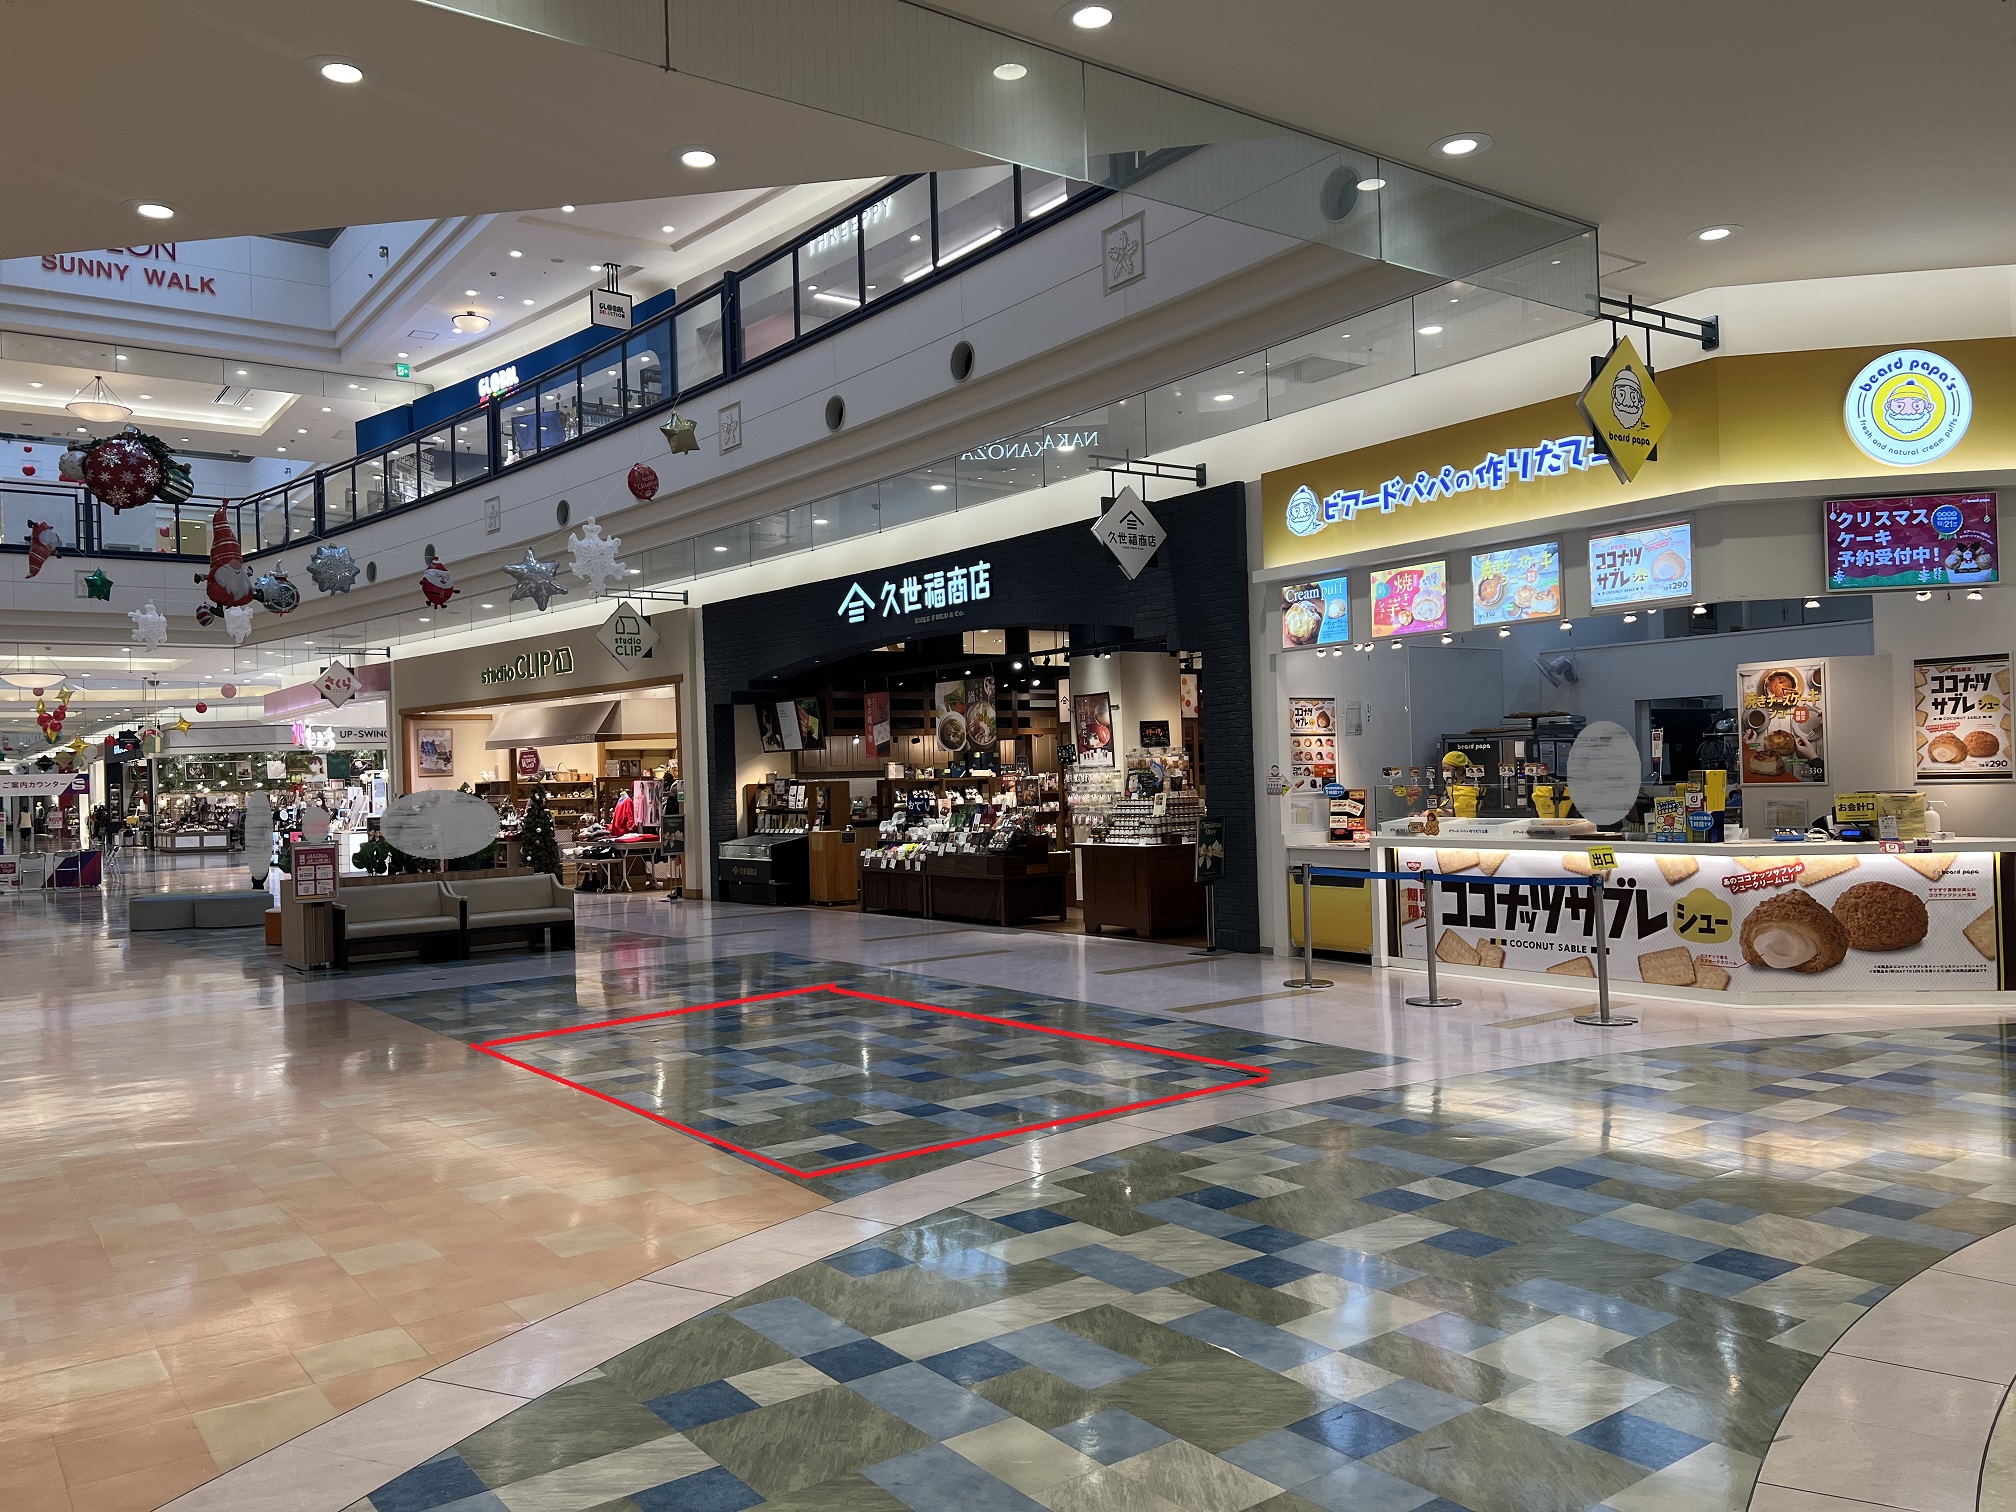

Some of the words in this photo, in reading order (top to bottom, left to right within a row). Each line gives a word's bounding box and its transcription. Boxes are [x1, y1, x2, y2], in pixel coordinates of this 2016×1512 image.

[41, 254, 129, 281] SUNNY
[143, 267, 216, 295] WALK
[599, 302, 625, 314] GLOBAL
[599, 309, 626, 319] SELECTION
[478, 365, 520, 397] GLOBAL
[1859, 357, 1903, 392] beard
[1909, 359, 1957, 391] papa's
[1608, 431, 1630, 442] beard
[1632, 437, 1650, 447] papa
[1859, 419, 1872, 439] fresh
[1872, 438, 1888, 450] and
[1888, 448, 1920, 456] natural
[1922, 437, 1945, 453] cream
[1944, 418, 1958, 438] puffs
[1837, 508, 1929, 529] クリスマス
[1108, 531, 1156, 547] 久世福商店
[1837, 529, 1892, 548] ケーキ
[1482, 551, 1553, 580] 焼きチーズケーキ
[1595, 547, 1643, 570] ココナッツ
[1838, 546, 1940, 568] 予約受付中！
[880, 560, 991, 618] 久世福商店
[1500, 574, 1527, 586] シュー
[1597, 567, 1630, 590] サブレ
[1633, 572, 1649, 582] シュー
[1285, 588, 1319, 603] Cream
[1320, 580, 1344, 601] puff
[915, 616, 931, 624] KUZE
[615, 637, 642, 645] studio
[615, 645, 642, 656] CLIP
[481, 664, 515, 685] studio
[515, 650, 552, 680] CLIP
[324, 675, 352, 691] さくら
[1931, 672, 1992, 694] ココナッツ
[1745, 688, 1820, 709] 焼きチーズケーキ
[1932, 693, 1975, 715] サブレ
[1978, 699, 1999, 710] シュー
[1769, 708, 1795, 719] シュー
[1457, 742, 1475, 750] beard
[1475, 743, 1491, 751] papa
[2, 781, 67, 789] ご案内カウンター
[1838, 802, 1875, 812] お会計口
[1690, 820, 1712, 828] 1時間です
[1592, 853, 1614, 866] 出口
[1723, 864, 1803, 886] あのココナッツサブレが
[1441, 877, 1668, 939] ココナッツサブレ
[1677, 903, 1728, 935] シュー
[1509, 939, 1554, 951] COCONUT
[1557, 943, 1587, 954] SABLE
